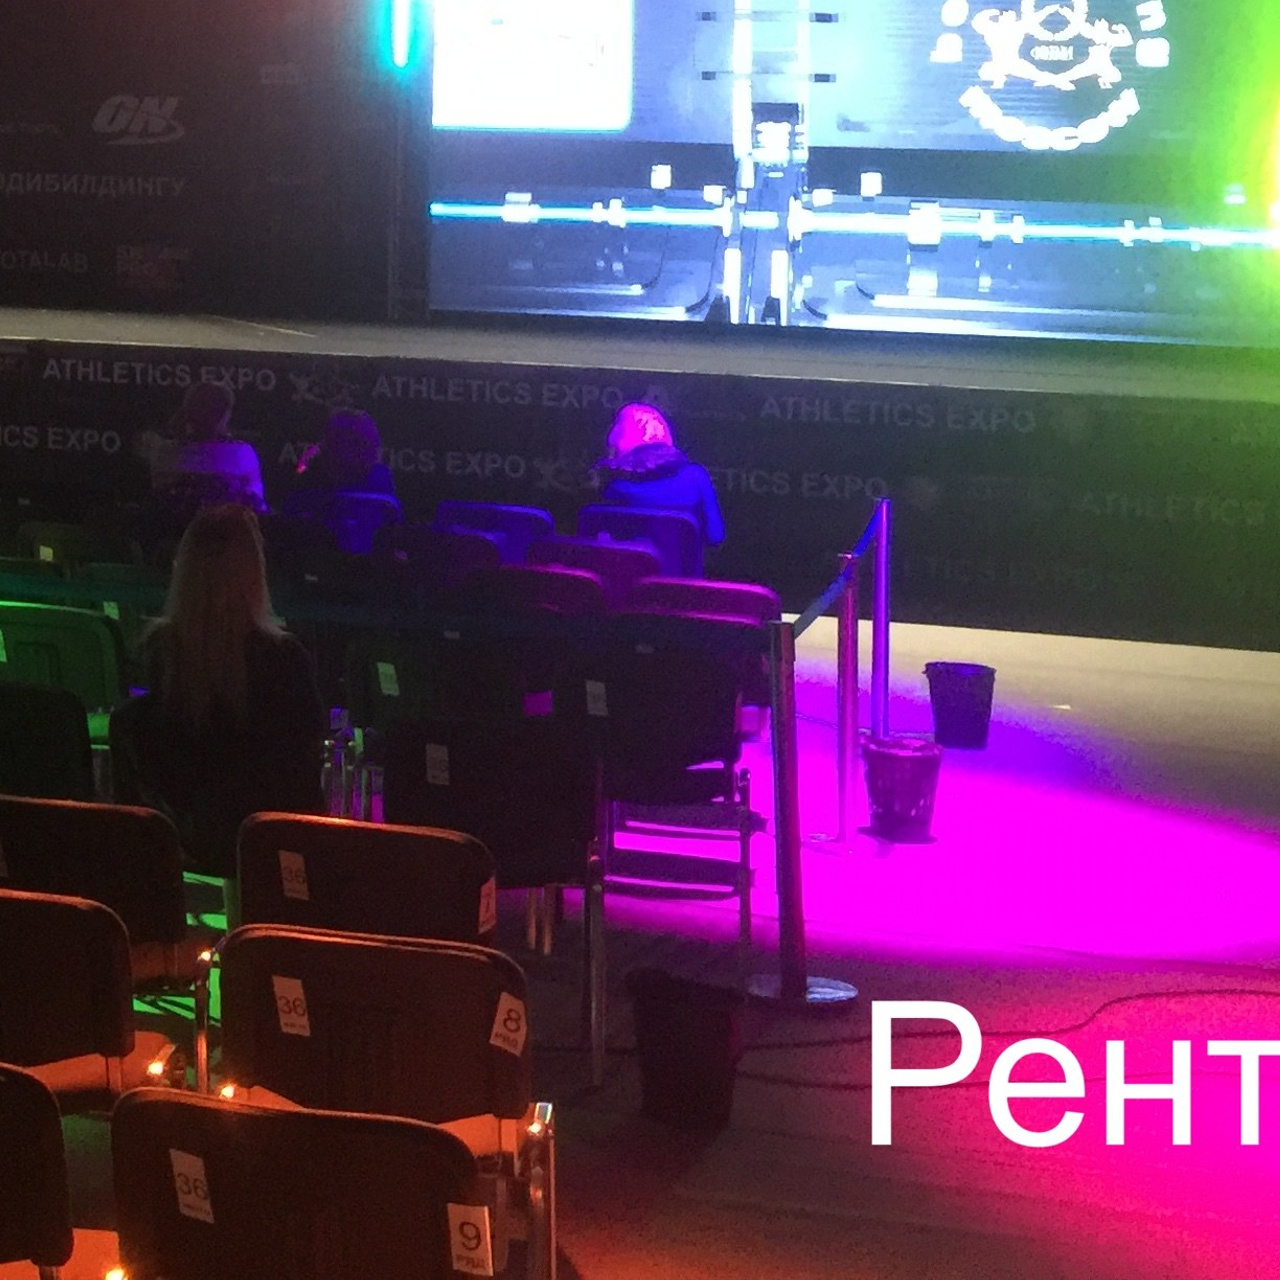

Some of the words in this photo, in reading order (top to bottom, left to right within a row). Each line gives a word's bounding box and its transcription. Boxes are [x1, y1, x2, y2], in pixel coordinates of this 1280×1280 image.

[43, 358, 191, 387] ATHLETICS
[201, 365, 276, 392] EXPO
[373, 375, 532, 407] ATHLETICS
[542, 383, 622, 410] EXPO
[760, 395, 935, 429] ATHLETICS
[947, 405, 1036, 434] EXPO
[47, 427, 121, 454] EXPO
[445, 451, 526, 479] EXPO
[801, 471, 888, 499] EXPO
[277, 994, 307, 1018] 36
[503, 1007, 523, 1033] 8
[176, 1171, 210, 1202] 36
[459, 1221, 482, 1252] 9
